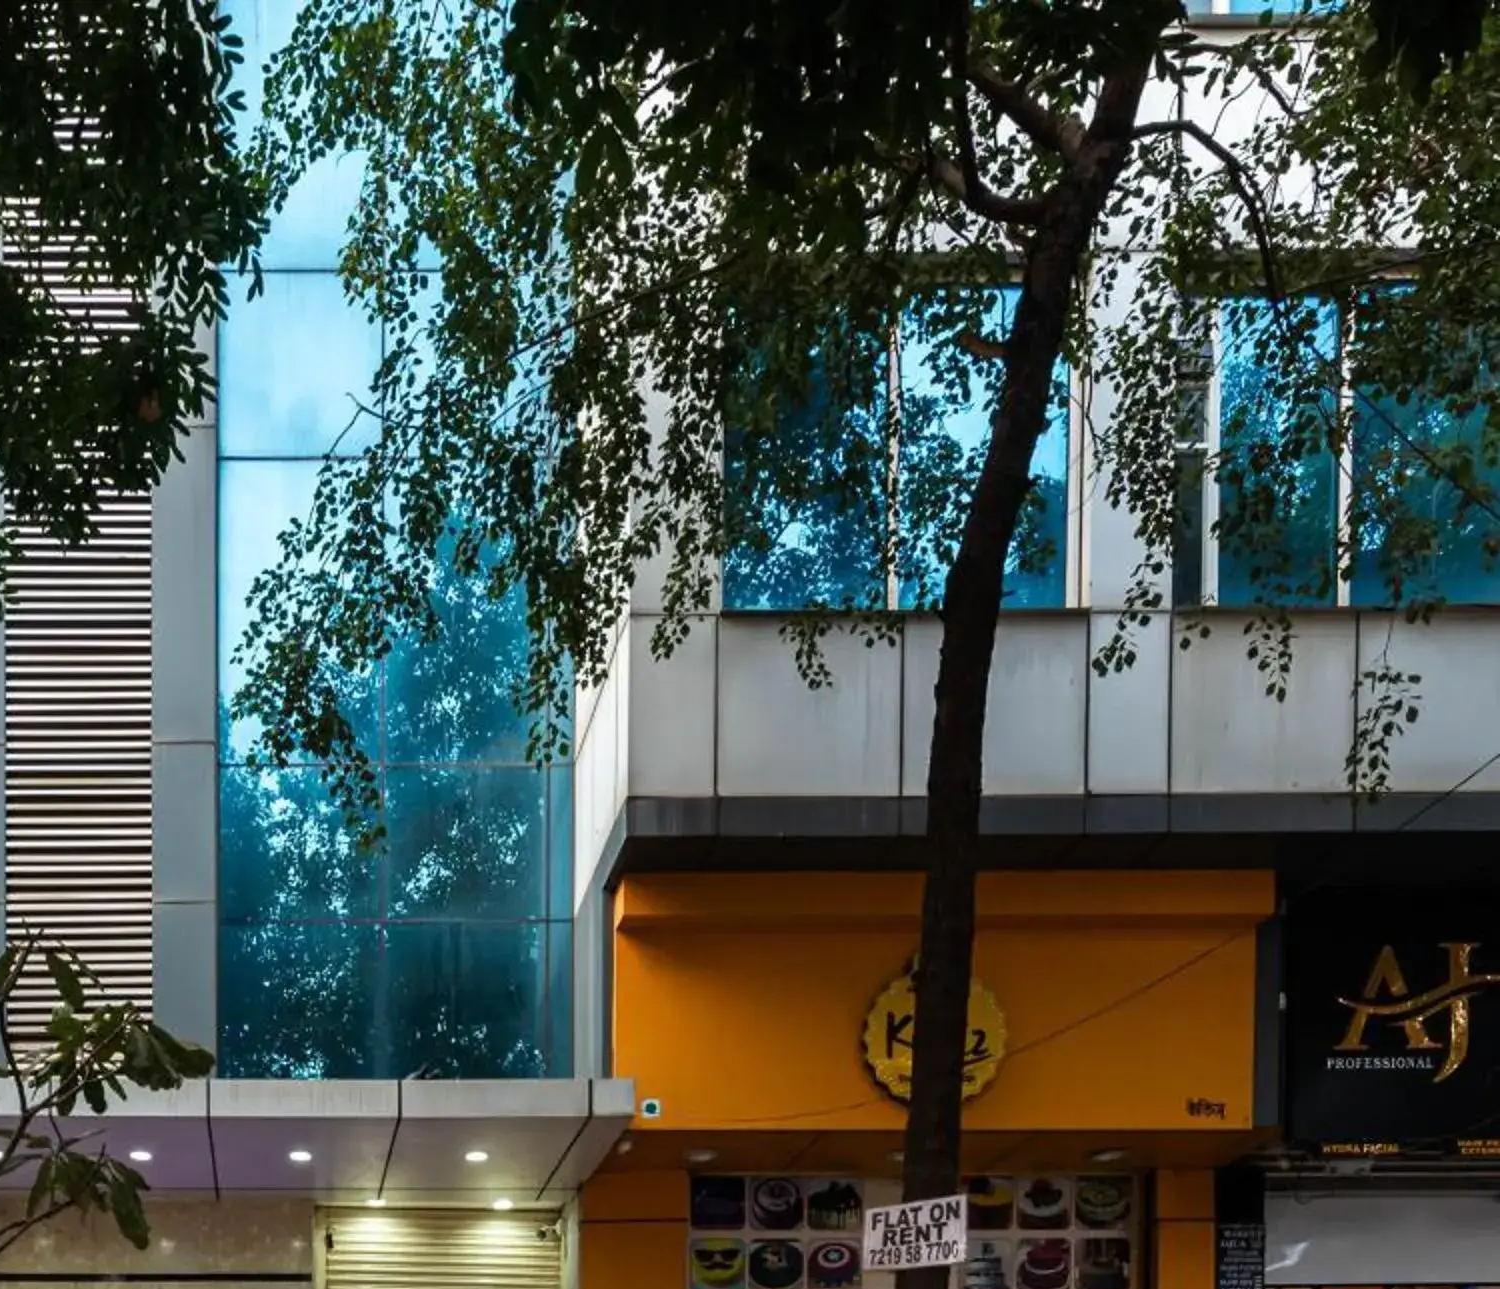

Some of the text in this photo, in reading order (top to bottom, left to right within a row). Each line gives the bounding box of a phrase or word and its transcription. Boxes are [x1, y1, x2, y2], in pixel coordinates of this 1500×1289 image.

[1327, 1056, 1434, 1069] PROFESSIONAL
[872, 1200, 960, 1231] FLAT ON
[883, 1222, 947, 1247] RENT
